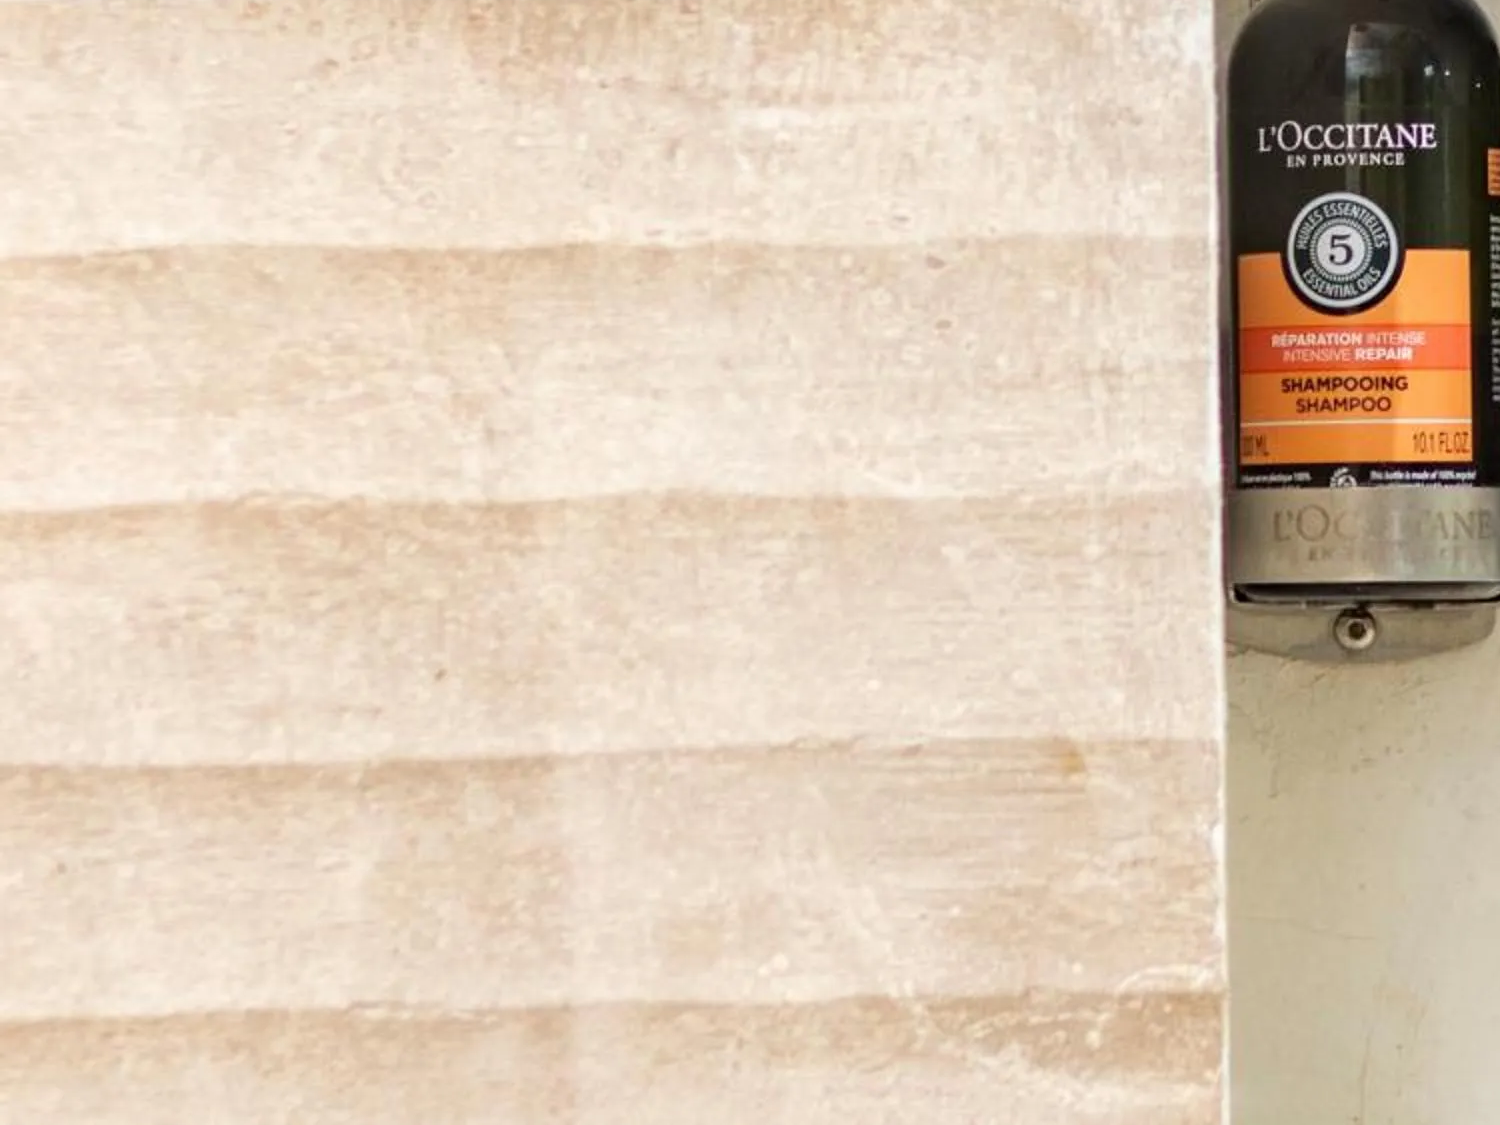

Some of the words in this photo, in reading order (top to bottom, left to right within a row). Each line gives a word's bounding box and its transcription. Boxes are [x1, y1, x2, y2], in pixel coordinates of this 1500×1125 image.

[1258, 120, 1437, 152] L'OCCITANE
[1287, 155, 1306, 168] EN
[1313, 153, 1405, 167] PROVENCE
[1322, 203, 1388, 249] ESSENTIELLES
[1329, 234, 1353, 265] 5
[1302, 268, 1358, 297] ESSENTIAL
[1357, 266, 1380, 291] OILS
[1366, 330, 1426, 345] INTENSE
[1283, 349, 1350, 362] INTENSIVE
[1355, 347, 1413, 361] REPAIR
[1281, 376, 1408, 393] SHAMPOOING
[1296, 396, 1391, 413] SHAMPOO
